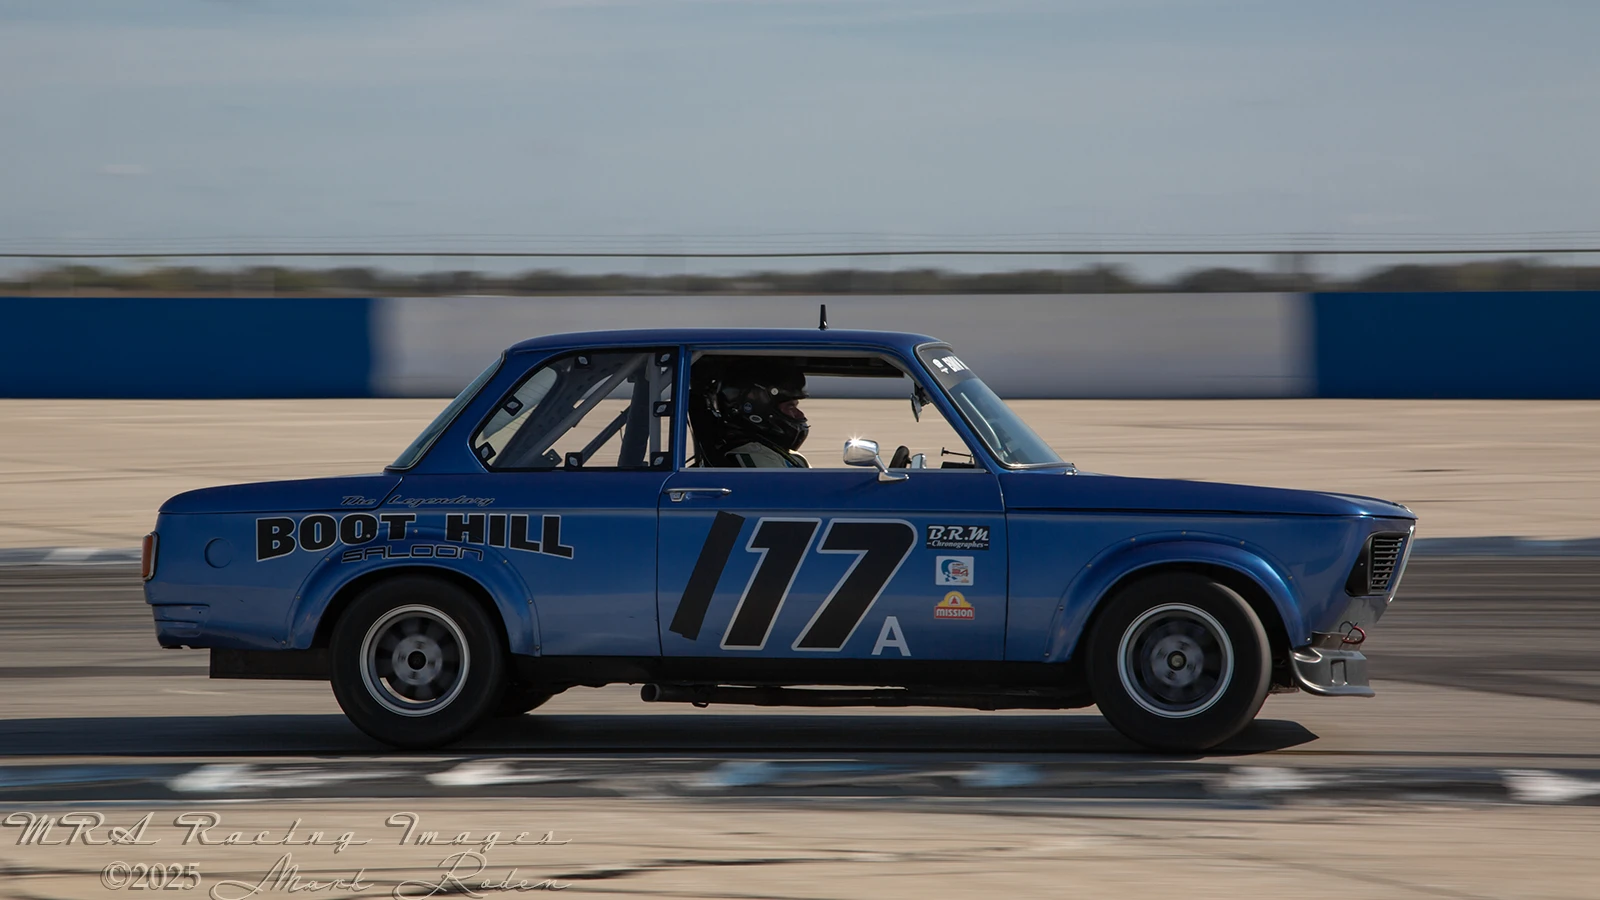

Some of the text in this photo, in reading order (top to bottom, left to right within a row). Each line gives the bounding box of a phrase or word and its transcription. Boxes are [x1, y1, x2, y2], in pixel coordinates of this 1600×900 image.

[340, 494, 496, 508] The Legendary
[256, 513, 575, 562] BOOT HILL
[341, 544, 484, 563] SALOON
[936, 608, 973, 617] MISSION
[871, 616, 912, 657] A
